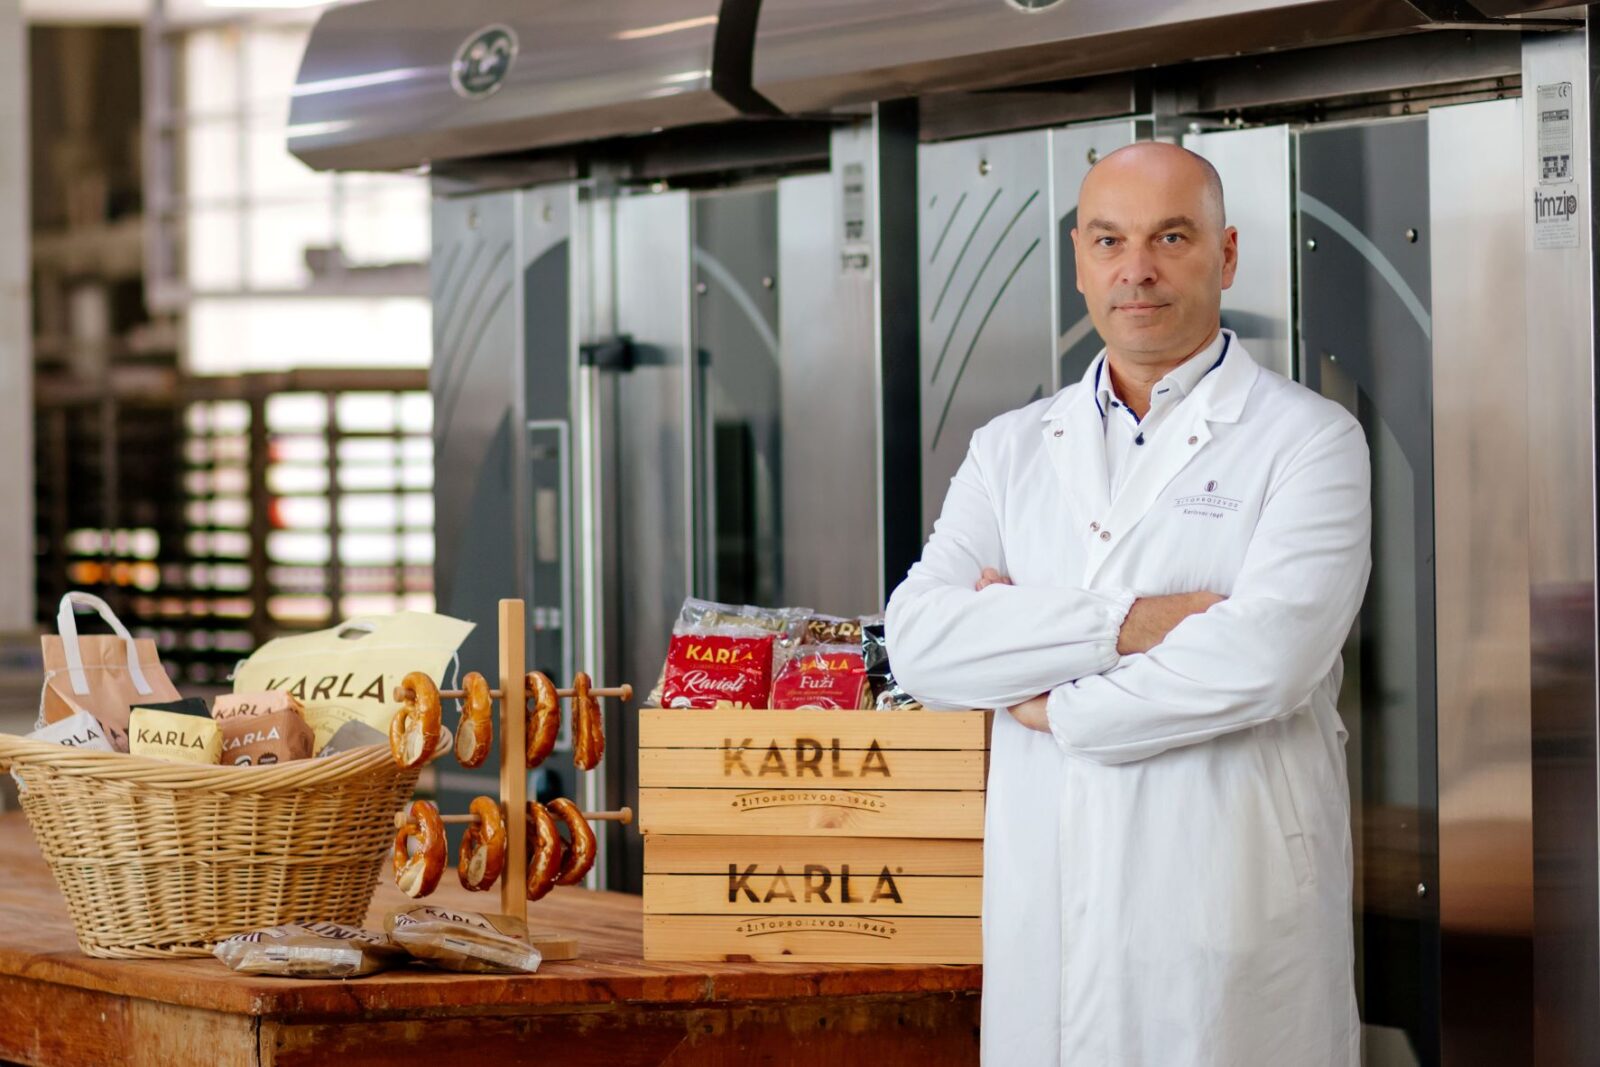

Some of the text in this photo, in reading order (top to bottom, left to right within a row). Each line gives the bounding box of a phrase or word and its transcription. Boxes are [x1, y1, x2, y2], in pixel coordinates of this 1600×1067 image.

[1534, 190, 1577, 223] timzip
[265, 672, 385, 704] KARLA
[682, 669, 746, 694] Ravioli
[799, 674, 834, 689] Fuži
[60, 728, 99, 747] RLA
[137, 728, 204, 750] KARLA
[222, 726, 280, 752] KARLA
[723, 738, 892, 777] KARLA
[741, 793, 876, 808] ŽITOPROIZVOD 1946
[728, 863, 903, 904] KARLA
[747, 920, 886, 934] ŽITOPROIZVOD 1946
